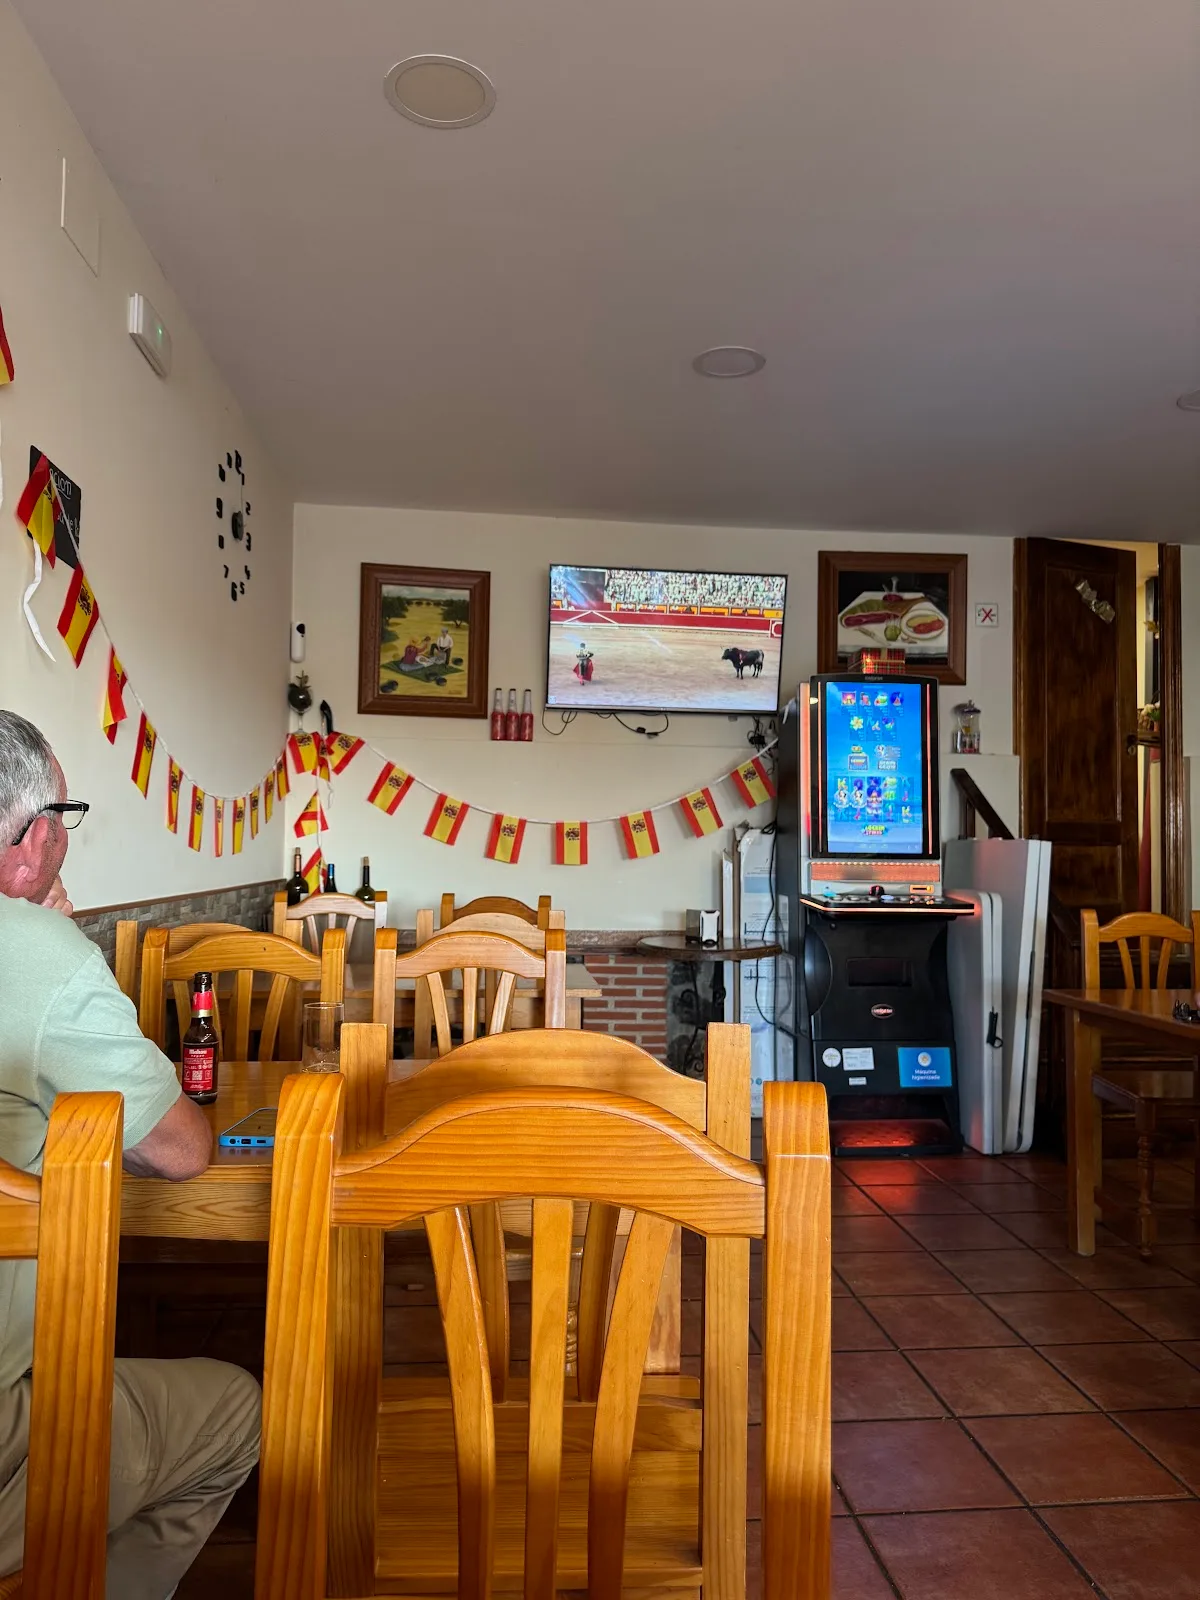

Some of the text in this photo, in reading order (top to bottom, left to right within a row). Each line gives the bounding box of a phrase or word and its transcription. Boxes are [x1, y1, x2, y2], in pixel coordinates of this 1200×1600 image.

[216, 497, 223, 519] 9
[245, 531, 252, 552] 3
[223, 564, 230, 579] 7
[244, 564, 251, 581] 4
